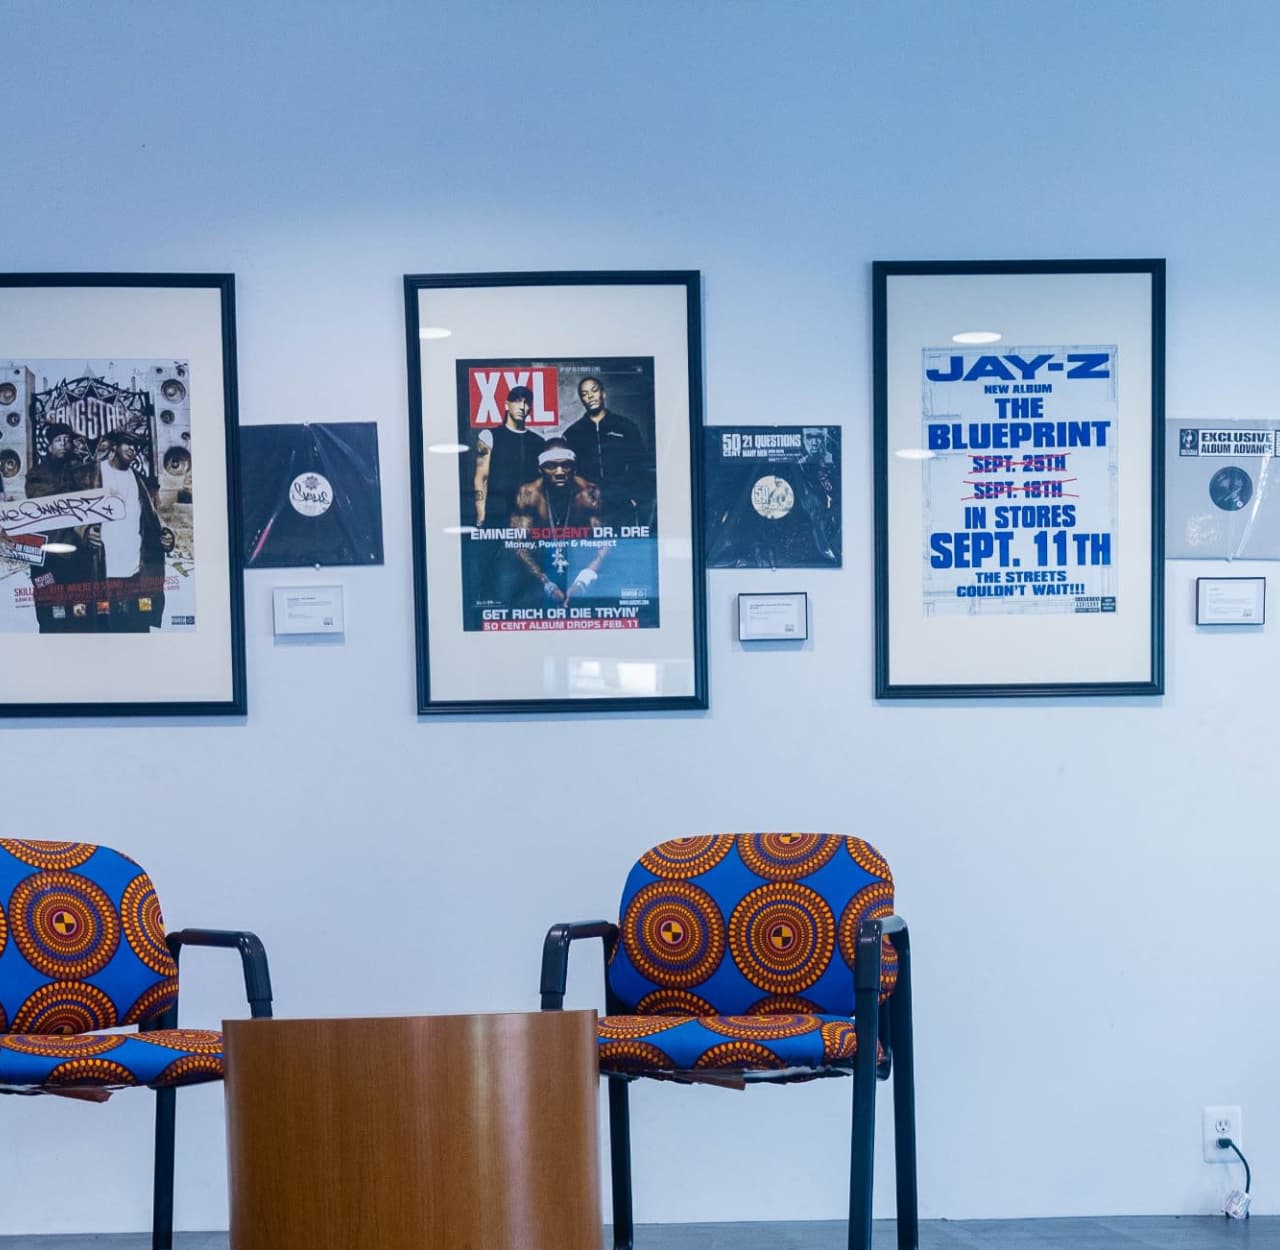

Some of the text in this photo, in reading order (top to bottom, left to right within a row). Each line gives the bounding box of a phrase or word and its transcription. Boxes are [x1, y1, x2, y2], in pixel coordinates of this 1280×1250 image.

[926, 353, 1110, 381] JAY-Z
[984, 384, 1052, 394] NEW ALBUM
[994, 397, 1043, 419] THE
[722, 433, 741, 450] 50
[742, 434, 801, 448] 21 QUESTIONS
[928, 421, 1111, 450] BLUEPRINT
[1201, 432, 1273, 442] EXCLUSIVE
[1201, 444, 1231, 453] ALBUM
[972, 454, 1066, 473] SEPT. 25TH
[974, 480, 1062, 499] SEPT. 18TH
[964, 504, 1076, 529] IN STORES
[471, 525, 649, 540] EMINEM 50 CENT DR. DRE
[505, 540, 536, 549] Money,
[539, 540, 568, 548] Power
[580, 540, 617, 549] Respect
[930, 531, 1020, 568] SEPT.
[975, 571, 1067, 583] THE STREETS
[956, 584, 1085, 597] COULDN'T WAIT!!!
[482, 607, 639, 620] GET RICH OR DIE TRYIN'
[483, 622, 497, 631] 50
[501, 622, 526, 630] CENT
[529, 621, 564, 630] ALBUM
[567, 621, 600, 629] DROPS
[627, 620, 639, 628] 11
